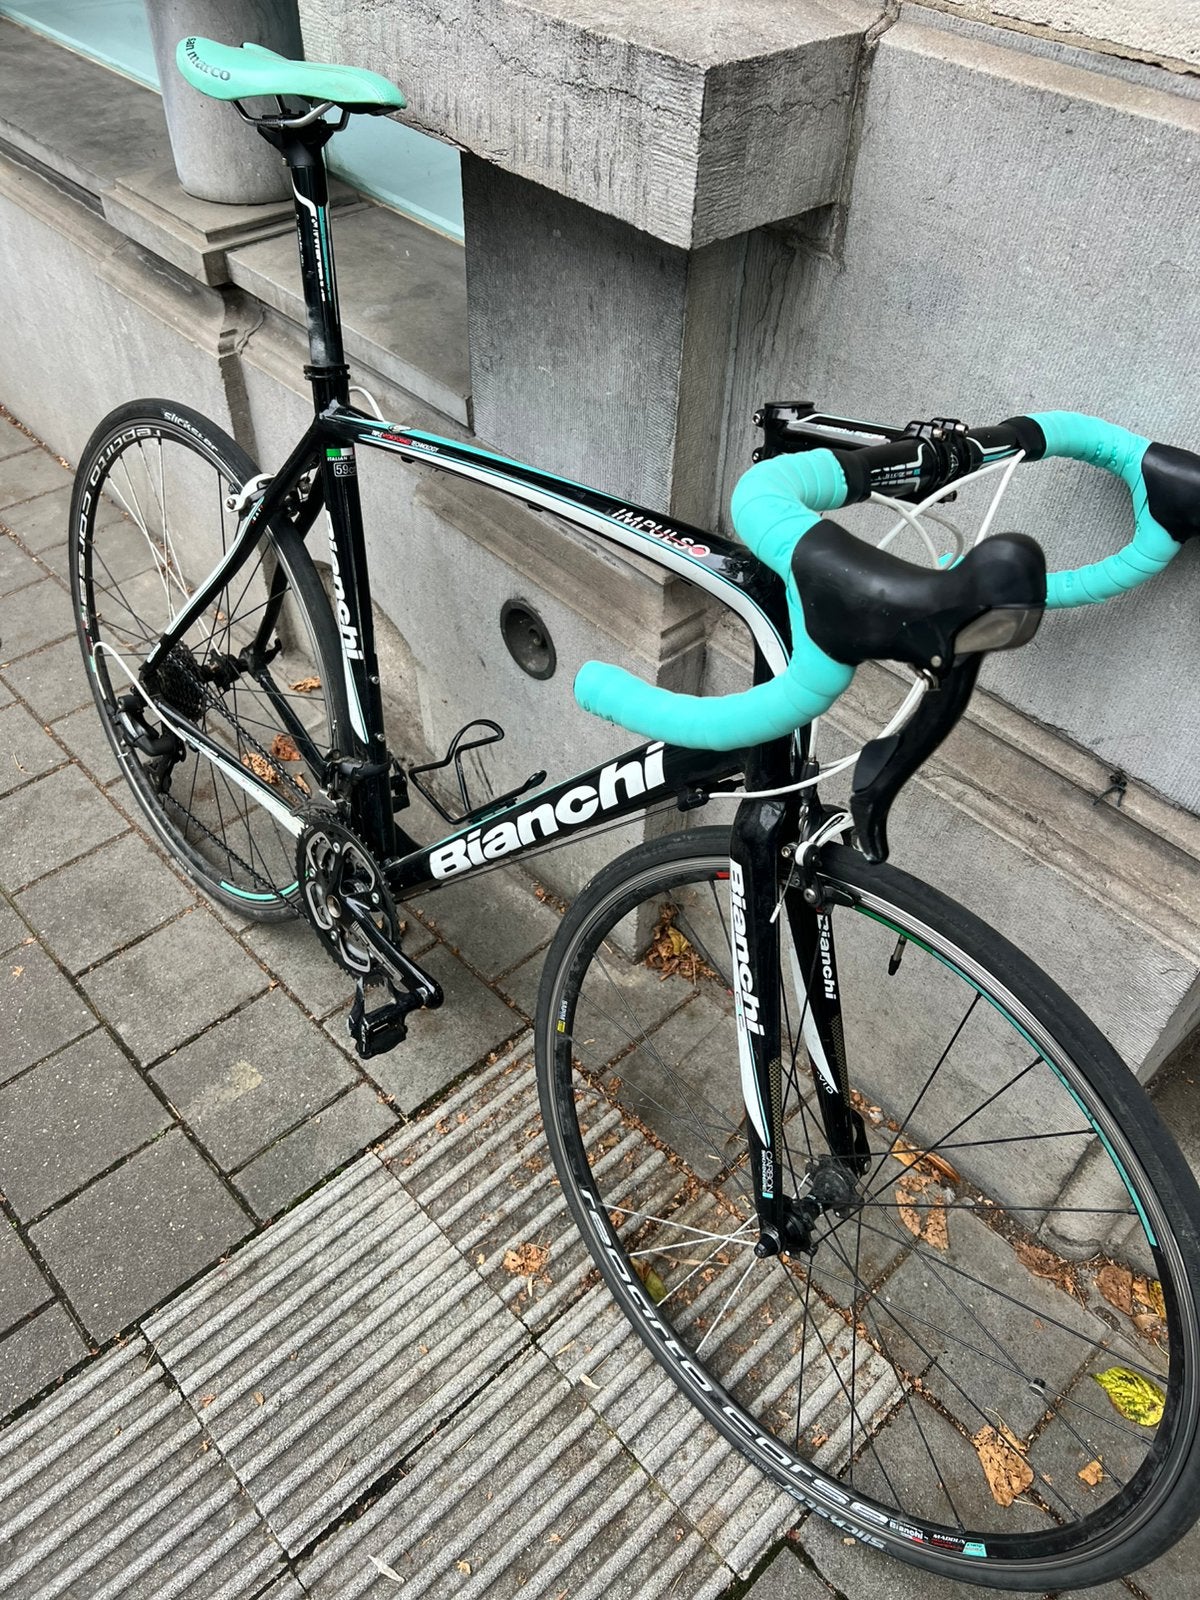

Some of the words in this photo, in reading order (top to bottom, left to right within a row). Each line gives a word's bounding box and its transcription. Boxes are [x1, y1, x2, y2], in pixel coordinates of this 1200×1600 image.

[187, 51, 231, 81] marco
[90, 427, 162, 487] reparto
[611, 508, 711, 557] IMPULSO
[429, 741, 666, 880] Bianchi
[730, 858, 765, 1036] Bianchi
[766, 1150, 774, 1194] CARBON
[581, 1188, 713, 1392] reparto
[722, 1406, 889, 1526] corse
[776, 1481, 887, 1550] slickster
[889, 1520, 924, 1540] Bianchi
